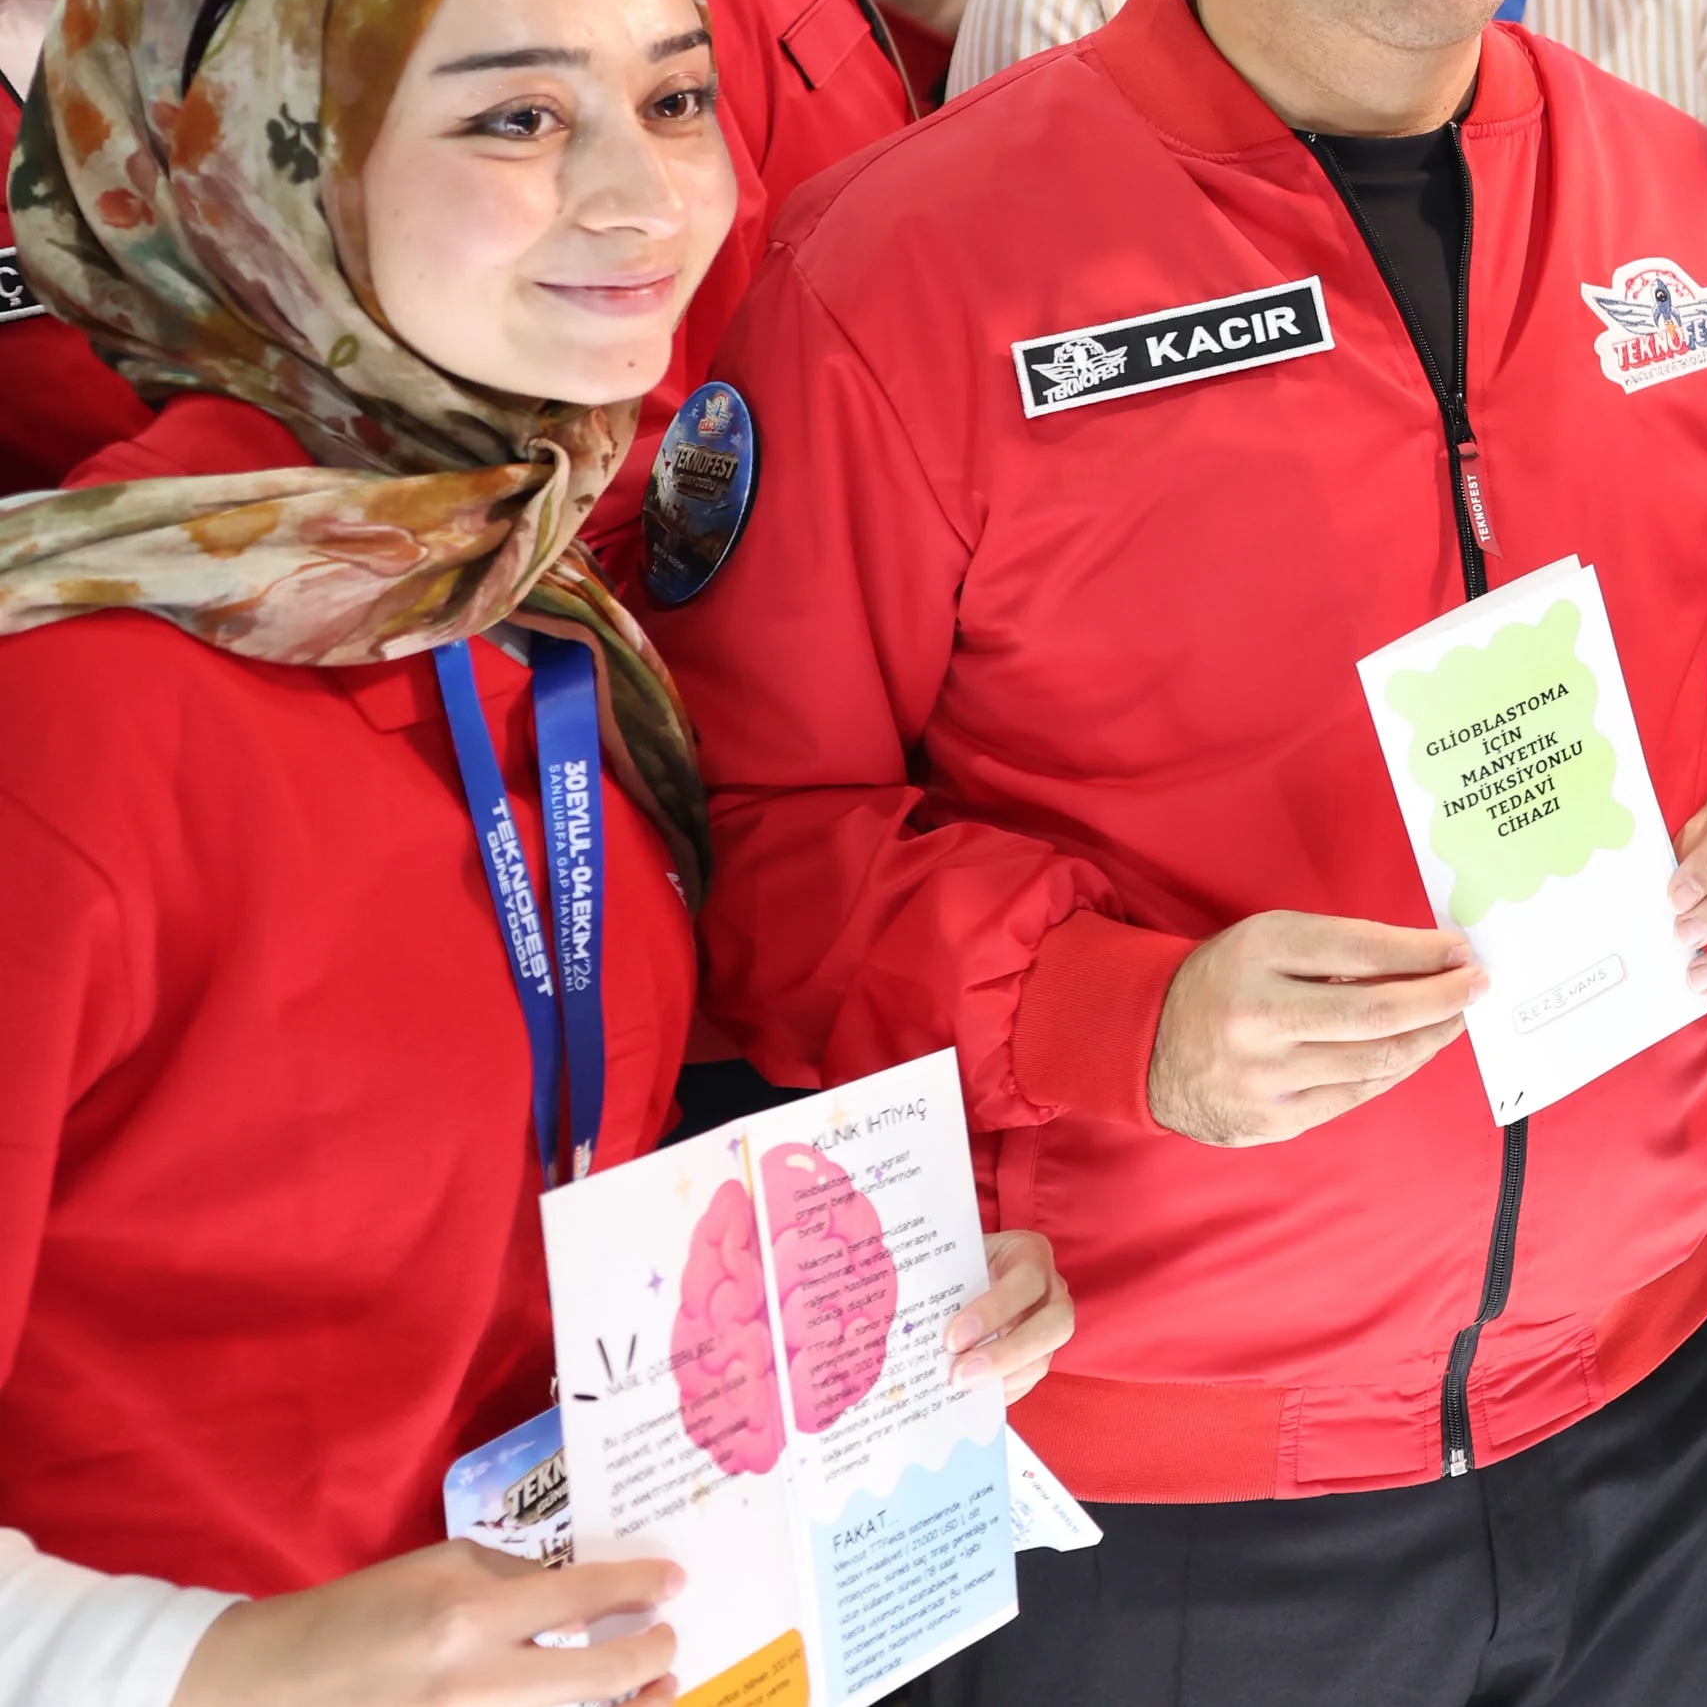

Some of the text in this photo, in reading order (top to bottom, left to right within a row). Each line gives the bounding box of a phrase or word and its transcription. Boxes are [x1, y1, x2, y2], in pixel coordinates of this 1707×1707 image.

[1146, 305, 1301, 367] KACIR
[1043, 357, 1127, 405] TEKNOFEST
[675, 444, 738, 480] TEKNOFEST
[1466, 475, 1491, 542] TEKNOFEST
[1425, 682, 1570, 758] GLİOBLASTOMA
[1482, 725, 1523, 756] İÇİN
[1442, 740, 1585, 819] İNDÜKSİYONLU
[1460, 731, 1560, 789] MANYETİK
[1486, 773, 1556, 821] TEDAVİ
[1496, 797, 1562, 838] CİHAZI
[557, 856, 569, 889] GAP
[492, 797, 554, 997] TEKNOFEST
[865, 1094, 928, 1137] İHTİYAÇ
